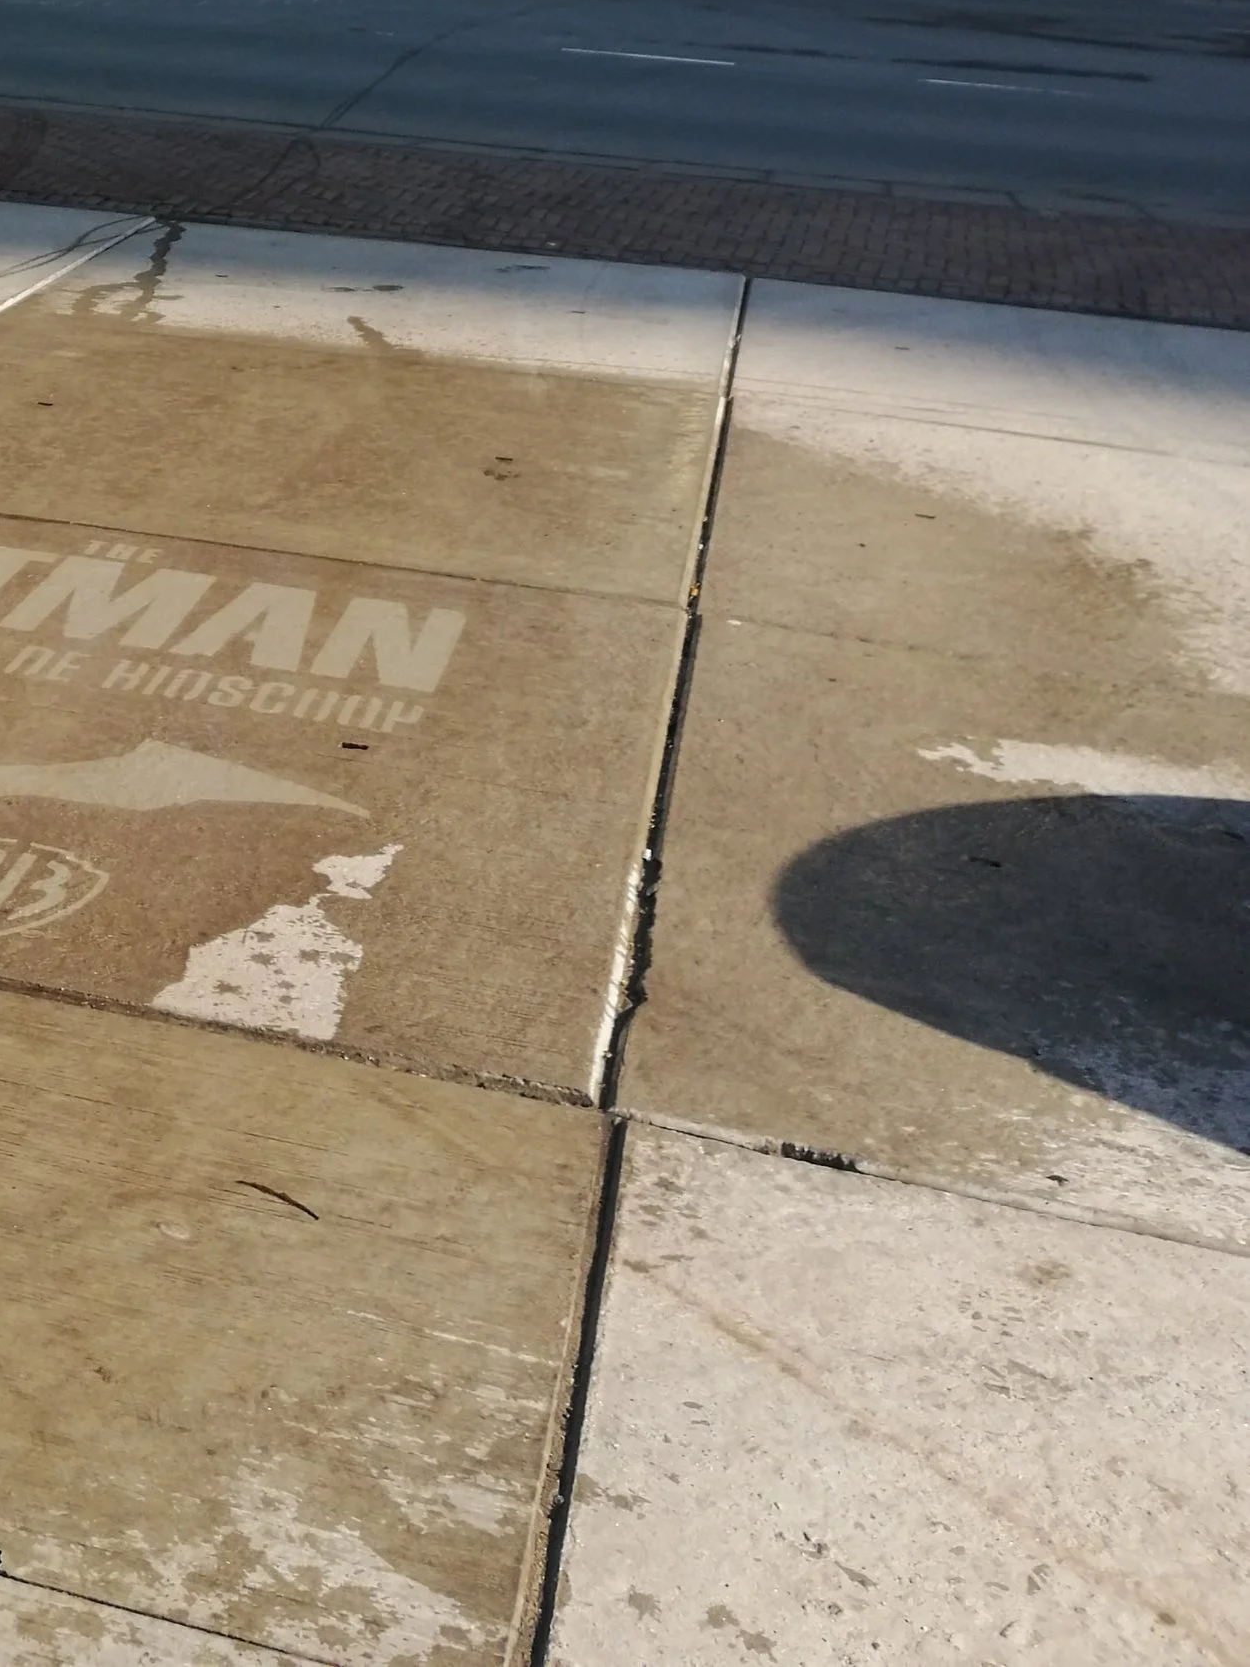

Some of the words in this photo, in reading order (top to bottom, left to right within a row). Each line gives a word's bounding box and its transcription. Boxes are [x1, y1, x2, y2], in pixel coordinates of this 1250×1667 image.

[85, 539, 163, 564] THE
[4, 645, 94, 683] DE
[100, 658, 425, 733] BIOSCOOP
